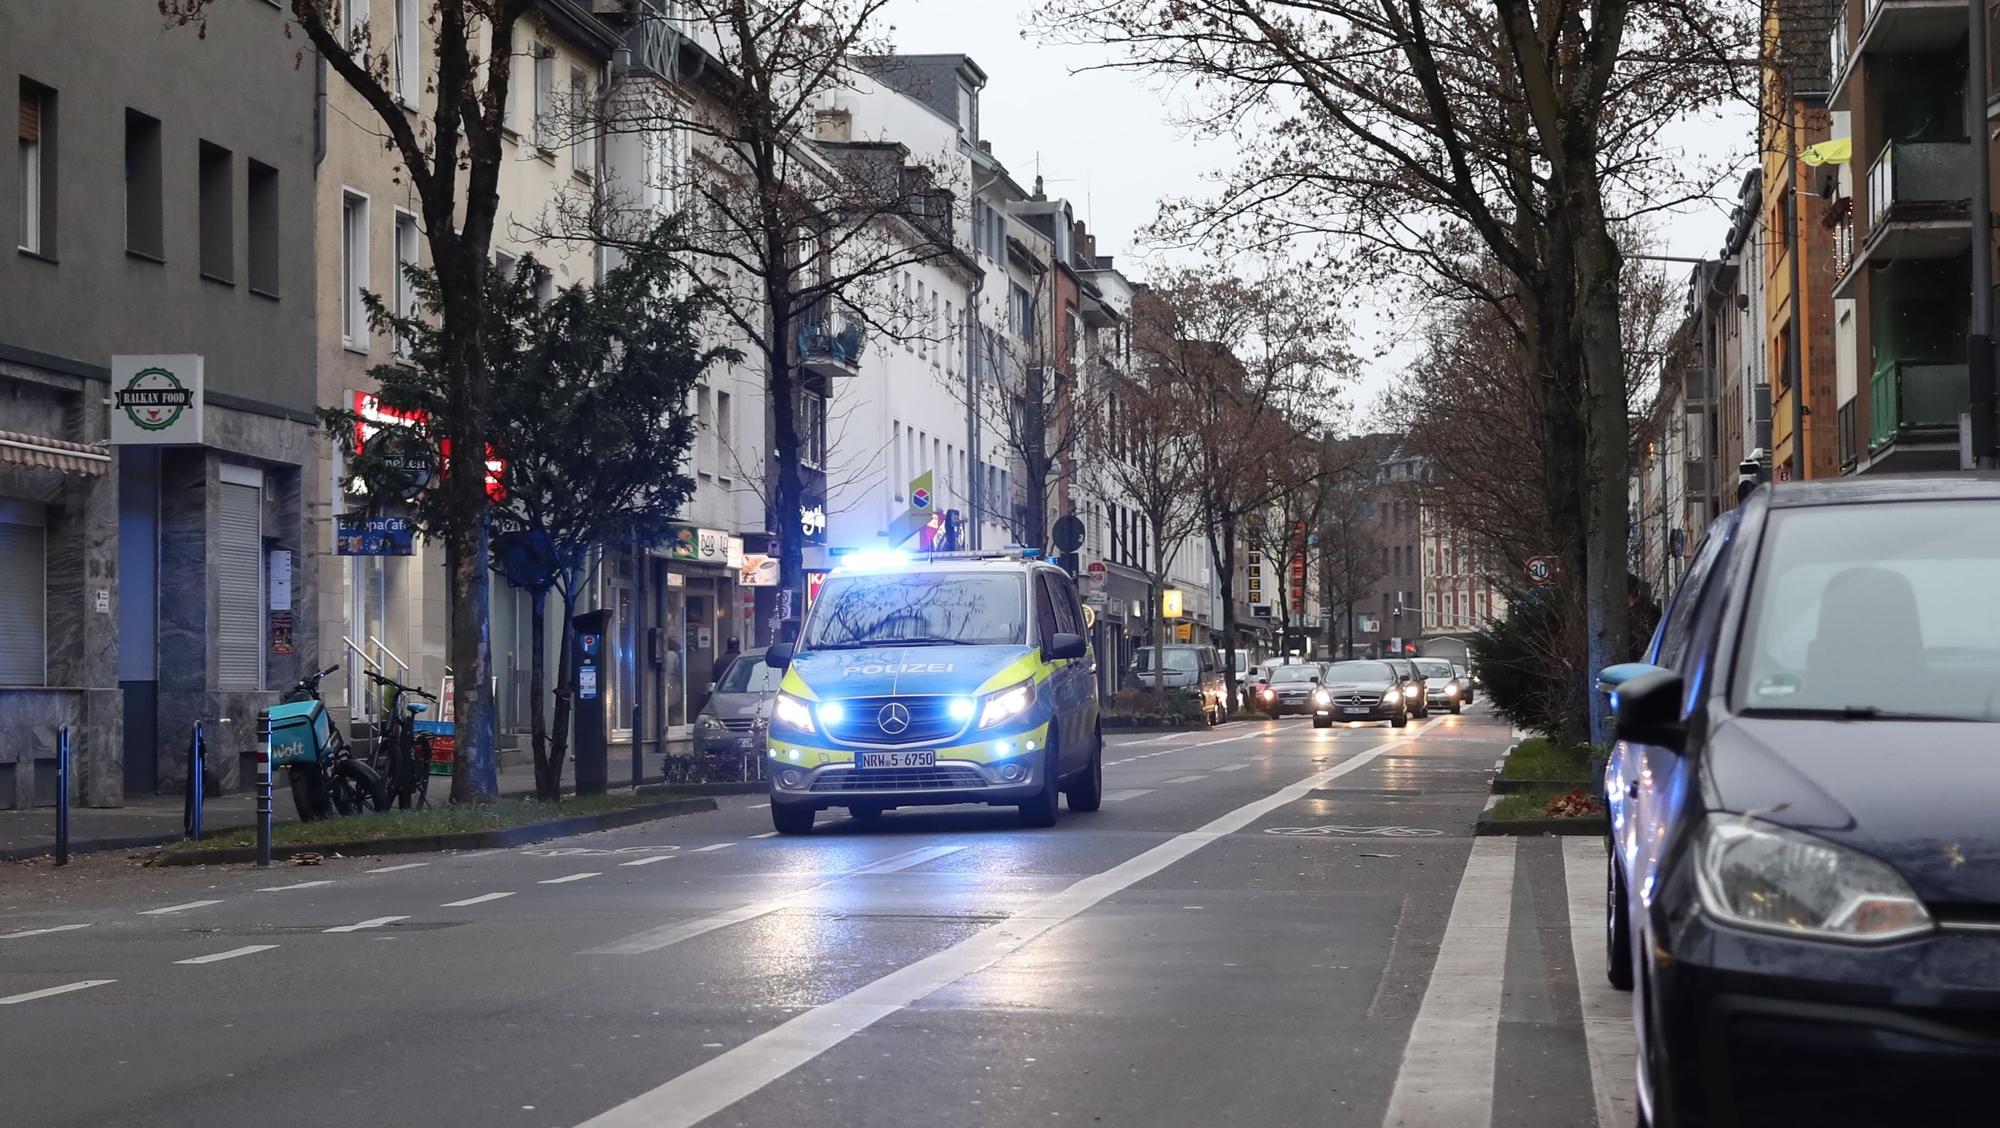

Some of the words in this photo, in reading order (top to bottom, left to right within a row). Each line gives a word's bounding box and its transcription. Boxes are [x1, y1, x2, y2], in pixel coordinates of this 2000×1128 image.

[124, 392, 159, 404] BALKAN
[162, 391, 185, 404] FOOD
[1530, 564, 1547, 577] 30
[843, 663, 954, 677] POLIZEI
[273, 742, 305, 758] Wolt
[863, 754, 885, 768] NRW
[891, 752, 934, 767] 5-6750
